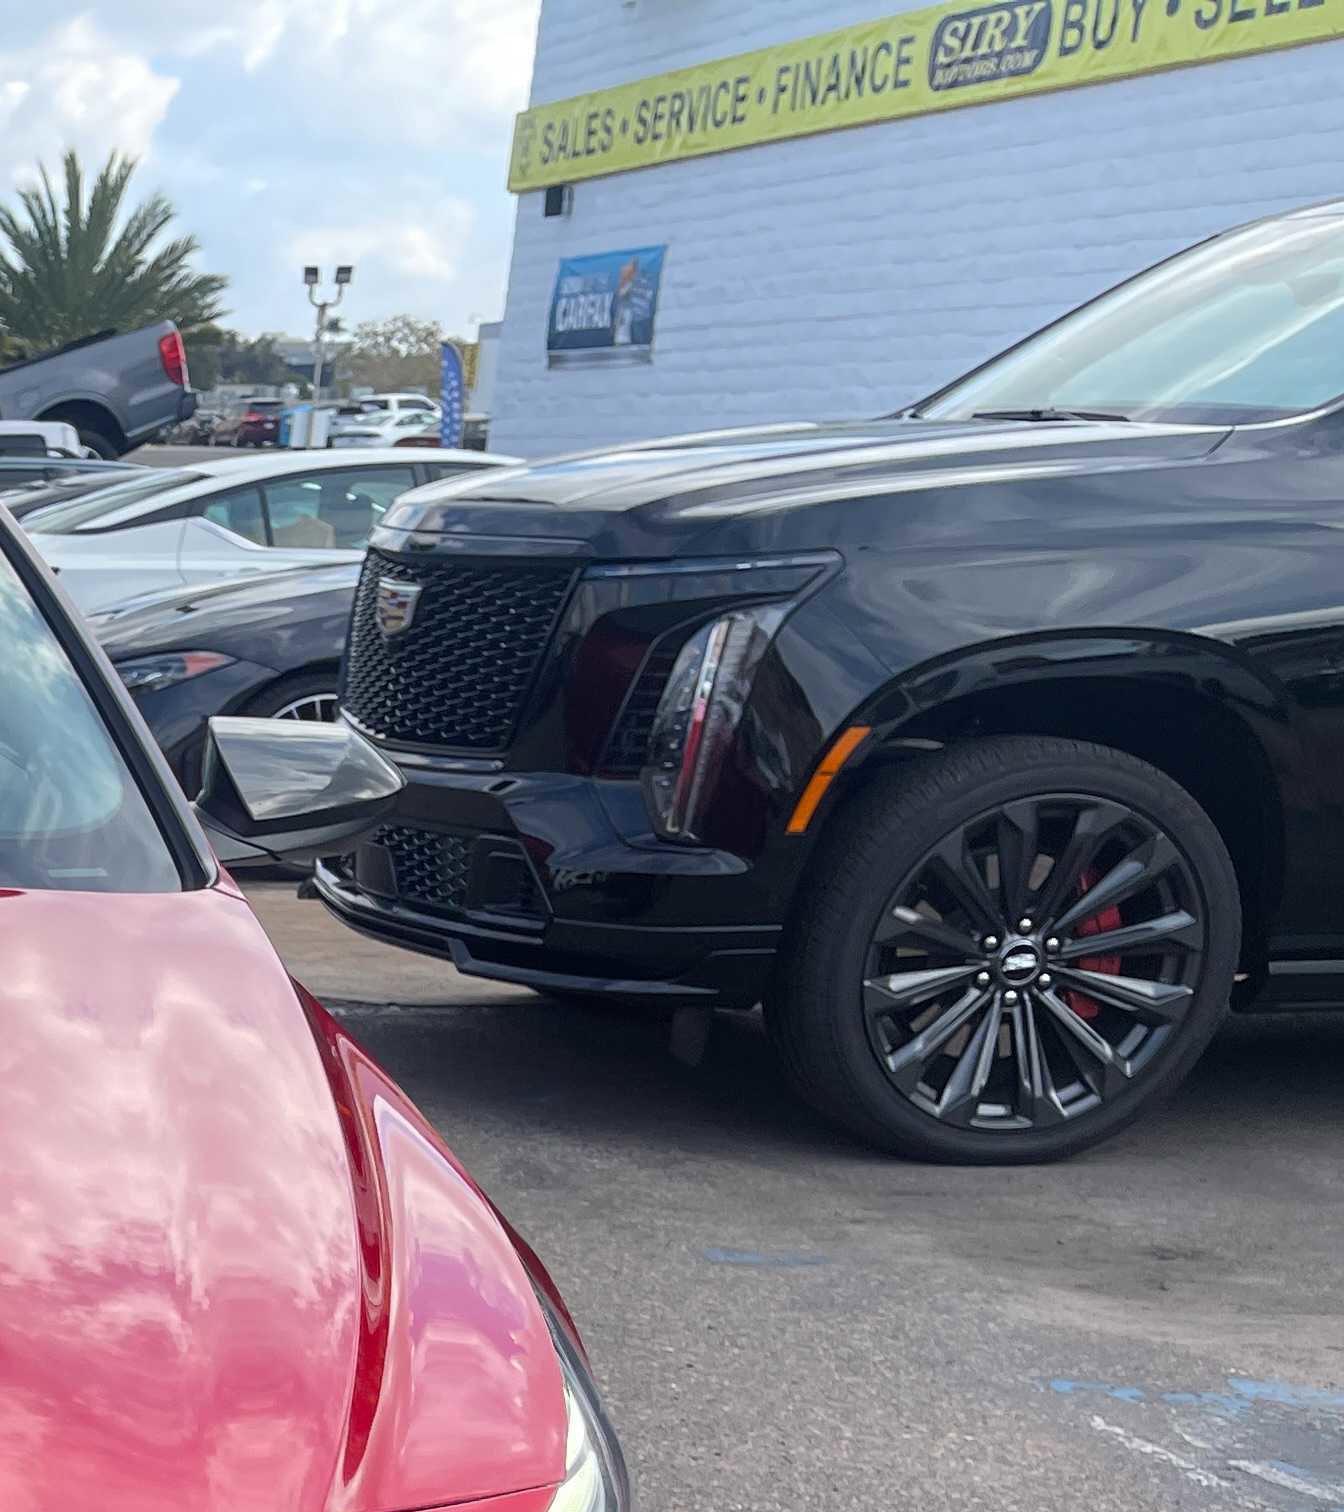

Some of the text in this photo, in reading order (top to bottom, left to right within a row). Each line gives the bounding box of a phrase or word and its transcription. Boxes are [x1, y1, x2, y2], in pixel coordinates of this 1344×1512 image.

[934, 2, 1047, 64] SIRY
[1058, 0, 1146, 57] BUY
[540, 36, 917, 166] SALES SERVICE FINANCE
[555, 294, 613, 332] CARFAX
